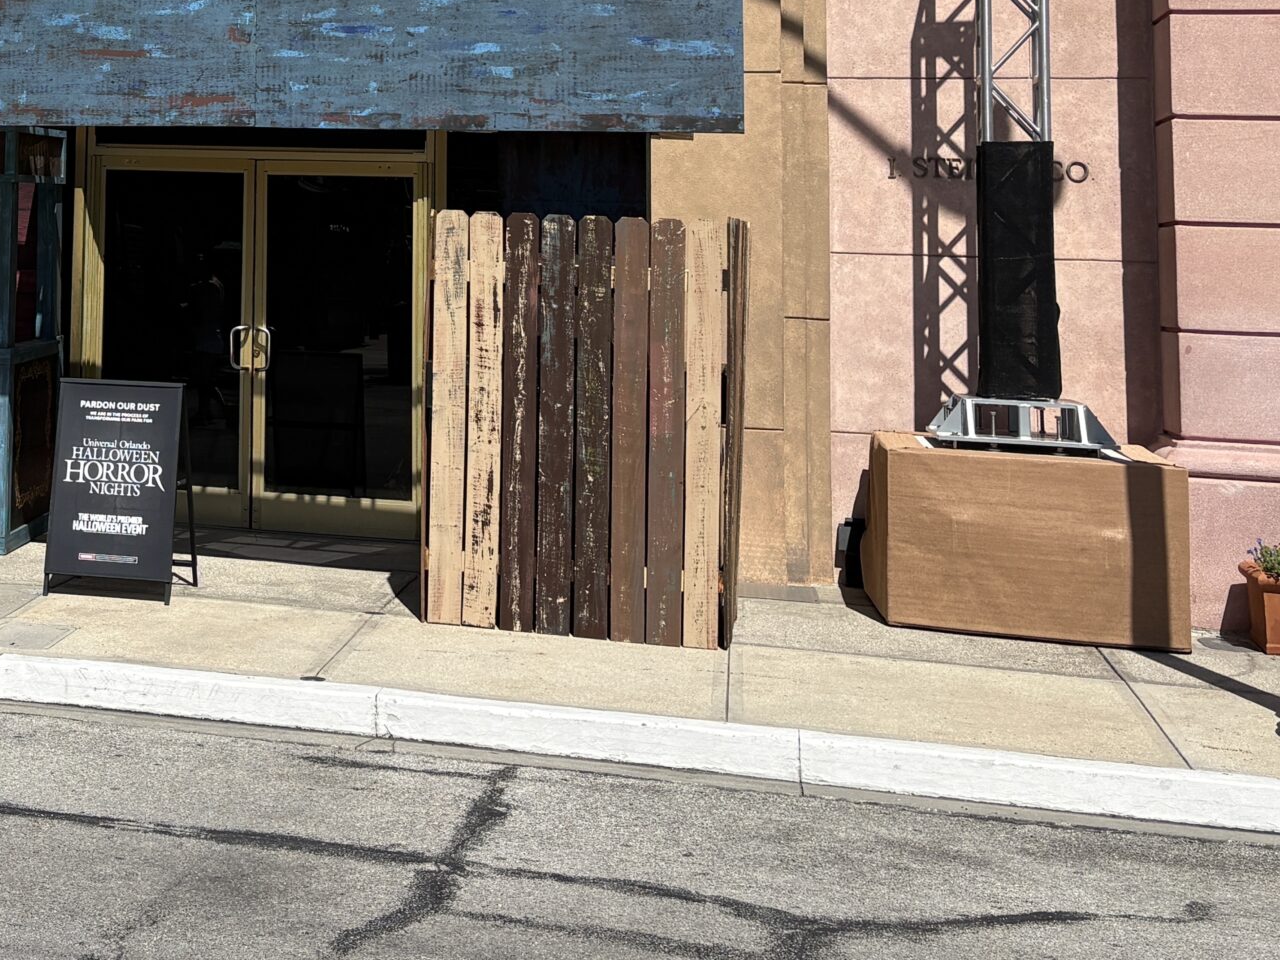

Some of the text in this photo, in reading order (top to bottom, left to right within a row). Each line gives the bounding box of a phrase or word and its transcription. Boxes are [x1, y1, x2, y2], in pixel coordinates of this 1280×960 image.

[80, 400, 160, 412] PARDON OUR DUST
[83, 437, 150, 450] Universal Orlando
[72, 446, 160, 464] HALLOWEEN
[62, 459, 165, 492] HORROR
[88, 482, 141, 497] NIGHTS
[78, 512, 143, 524] THE WORLD'S PREMIER
[72, 520, 121, 533] HALLOWEEN
